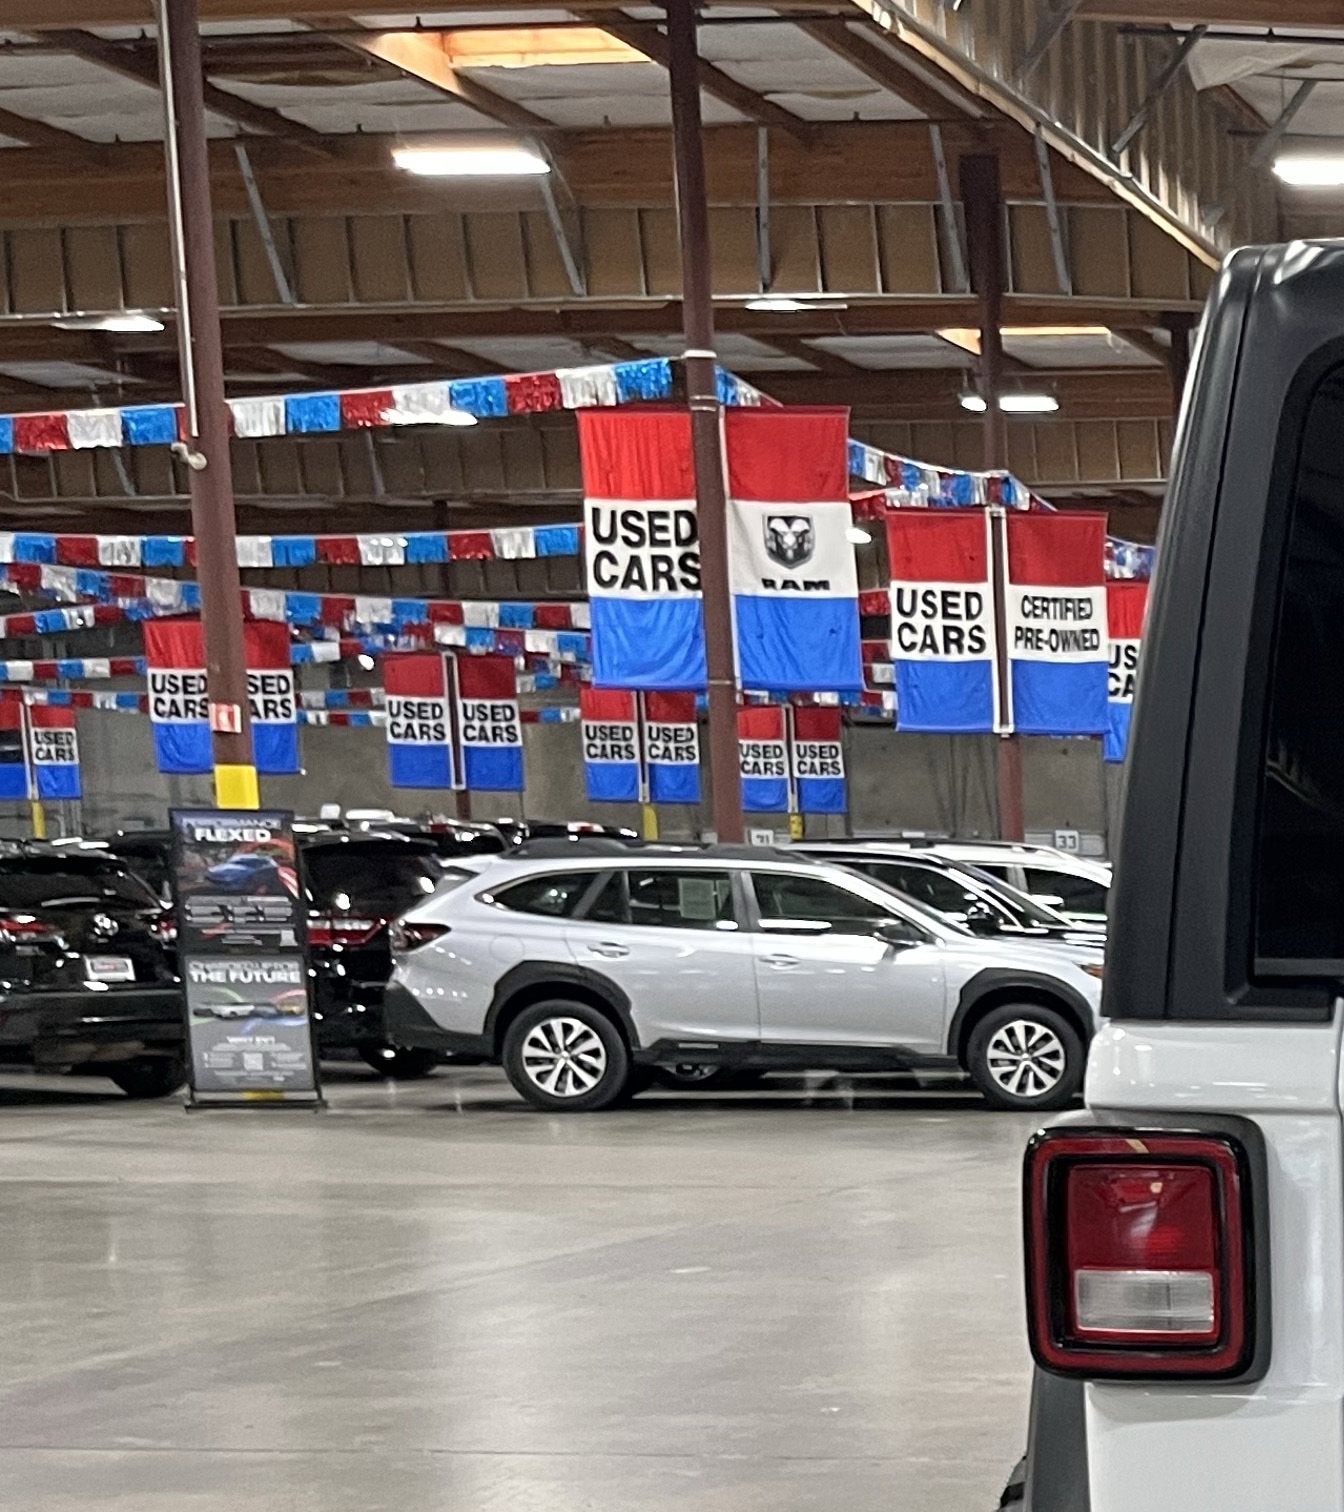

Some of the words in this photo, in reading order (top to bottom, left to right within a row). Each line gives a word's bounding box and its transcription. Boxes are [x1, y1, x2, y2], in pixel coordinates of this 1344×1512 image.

[591, 507, 698, 548] USED
[593, 550, 701, 592] CARS
[761, 577, 831, 591] RAM
[896, 588, 984, 621] USED
[1021, 595, 1093, 621] CERTIFIED
[897, 622, 987, 655] CARS
[1014, 626, 1100, 653] PRE-OWNED
[1109, 645, 1138, 671] US
[151, 674, 209, 695] USED
[247, 674, 291, 695] SED
[1109, 672, 1135, 699] CA
[154, 697, 209, 719] CARS
[250, 698, 292, 720] ARS
[388, 700, 444, 720] USED
[462, 702, 516, 722] USED
[34, 730, 75, 746] USED
[389, 721, 447, 741] CARS
[463, 724, 519, 743] CARS
[585, 724, 634, 742] USED
[648, 725, 695, 744] USED
[35, 747, 76, 762] CARS
[586, 743, 636, 760] CARS
[648, 743, 697, 761] CARS
[739, 743, 784, 759] USED
[796, 744, 839, 760] USED
[740, 760, 785, 776] CARS
[797, 760, 842, 776] CARS
[194, 828, 272, 843] FLEXED
[190, 969, 227, 984] THE
[229, 969, 301, 985] FUTURE
